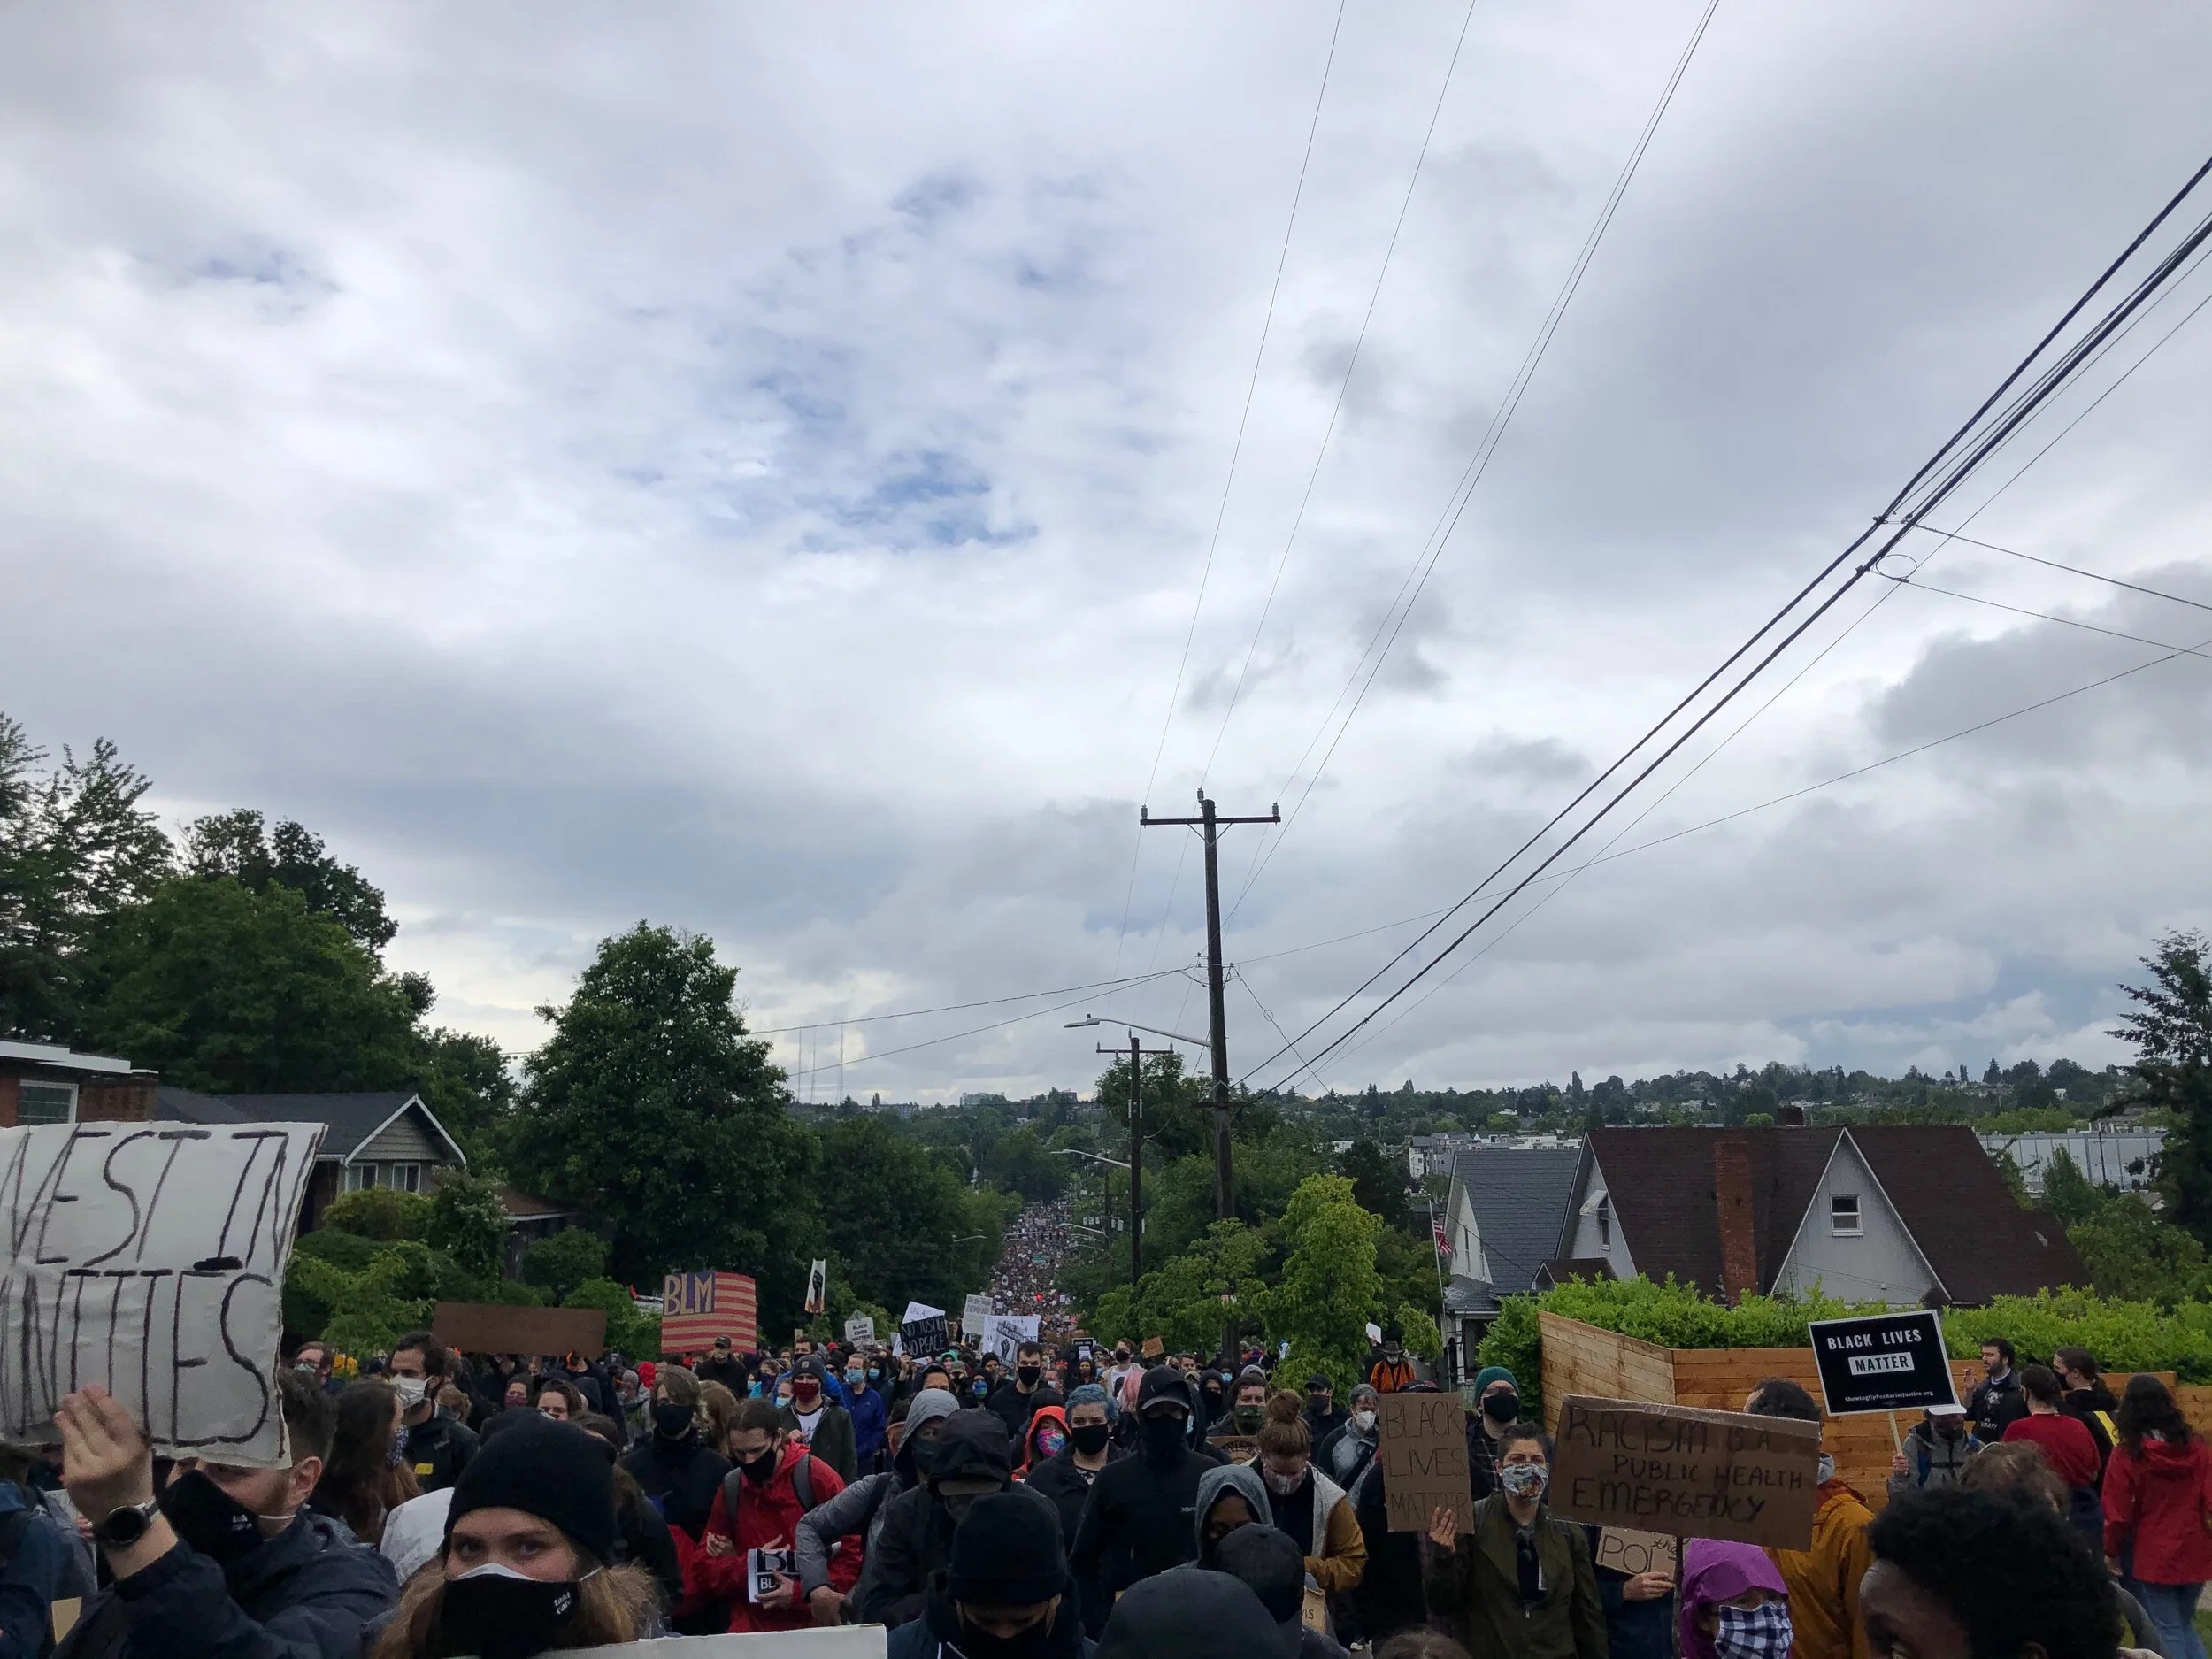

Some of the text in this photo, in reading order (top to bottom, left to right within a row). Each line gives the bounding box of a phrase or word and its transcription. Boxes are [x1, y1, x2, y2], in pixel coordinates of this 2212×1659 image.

[664, 1273, 713, 1316] BLM
[902, 1333, 946, 1356] NO PEACE
[1826, 1329, 1922, 1350] BLACK LIVES
[1855, 1356, 1909, 1372] MATTER
[1385, 1401, 1465, 1439] BLACK
[1565, 1405, 1708, 1455] RACISM
[1388, 1448, 1466, 1478] LIVES
[1612, 1454, 1803, 1490] PUBLIC HEALTH
[1571, 1477, 1766, 1524] EMERGENCY
